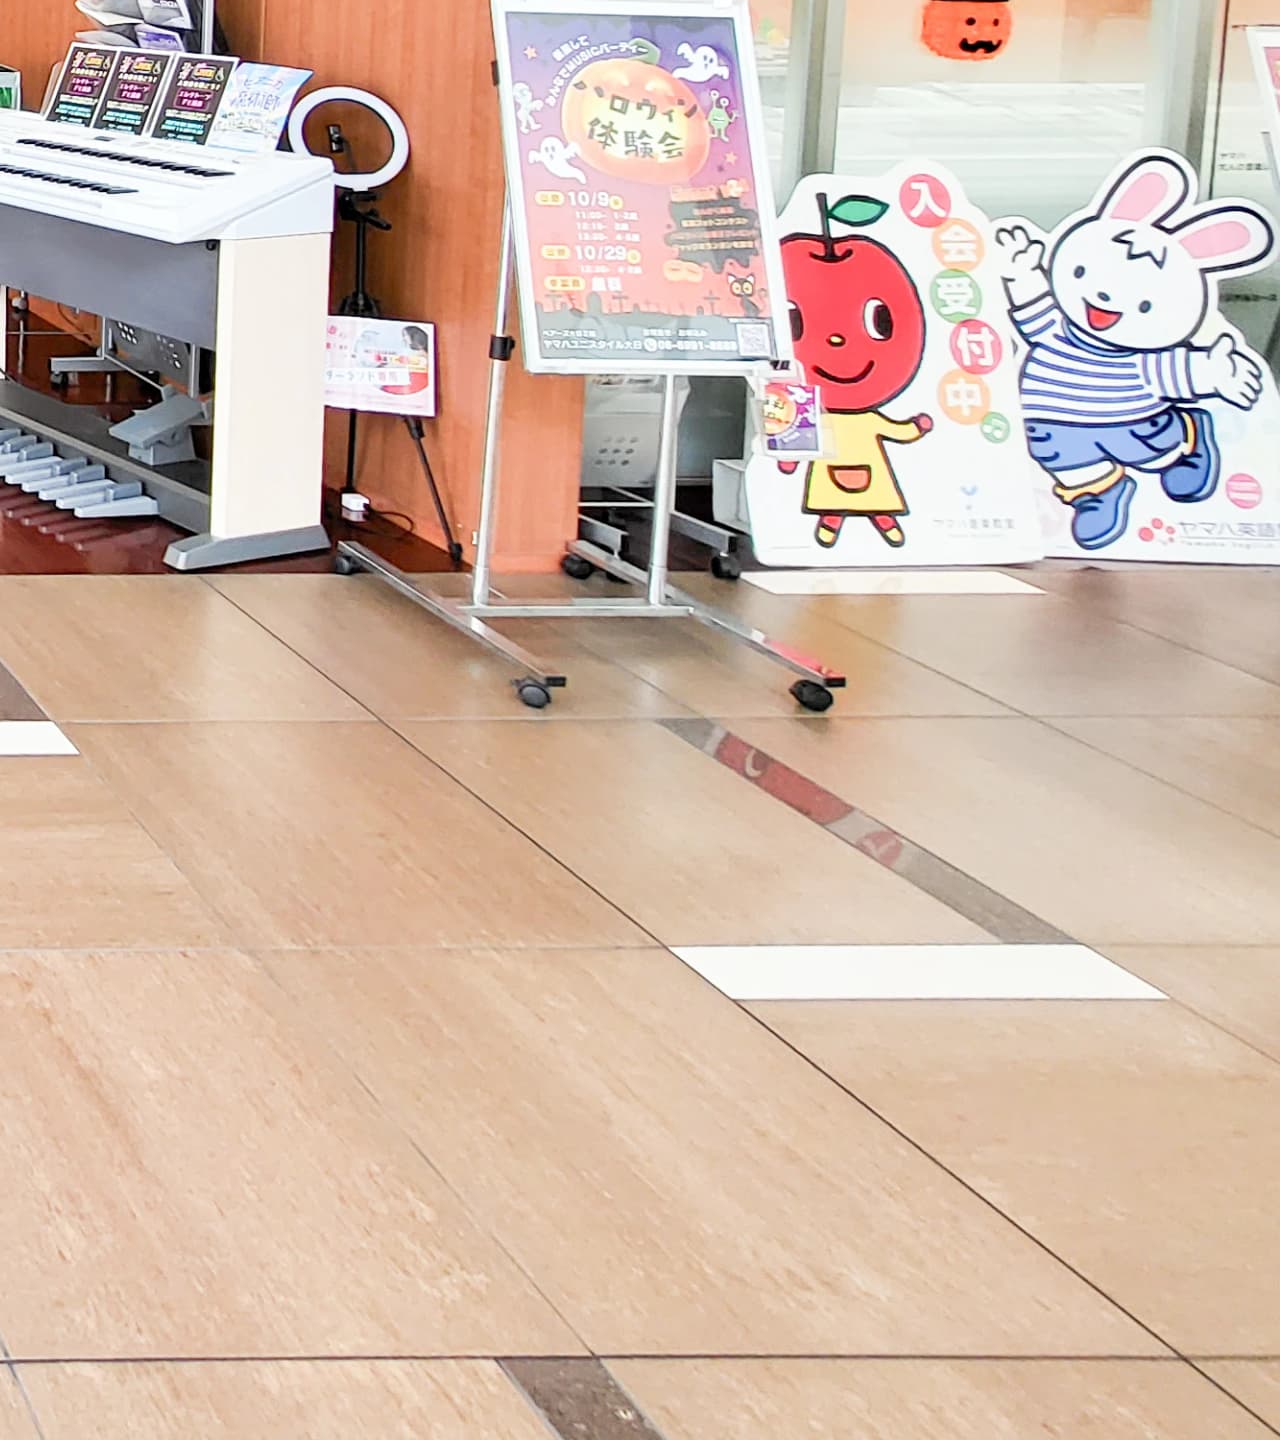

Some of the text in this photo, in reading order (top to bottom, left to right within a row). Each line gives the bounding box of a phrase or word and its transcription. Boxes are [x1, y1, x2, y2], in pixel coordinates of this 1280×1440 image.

[573, 79, 698, 121] ハロウィン
[587, 117, 684, 160] 体験会
[567, 191, 610, 207] 10/9
[575, 245, 627, 261] 10/29
[909, 181, 996, 418] 入会受付中
